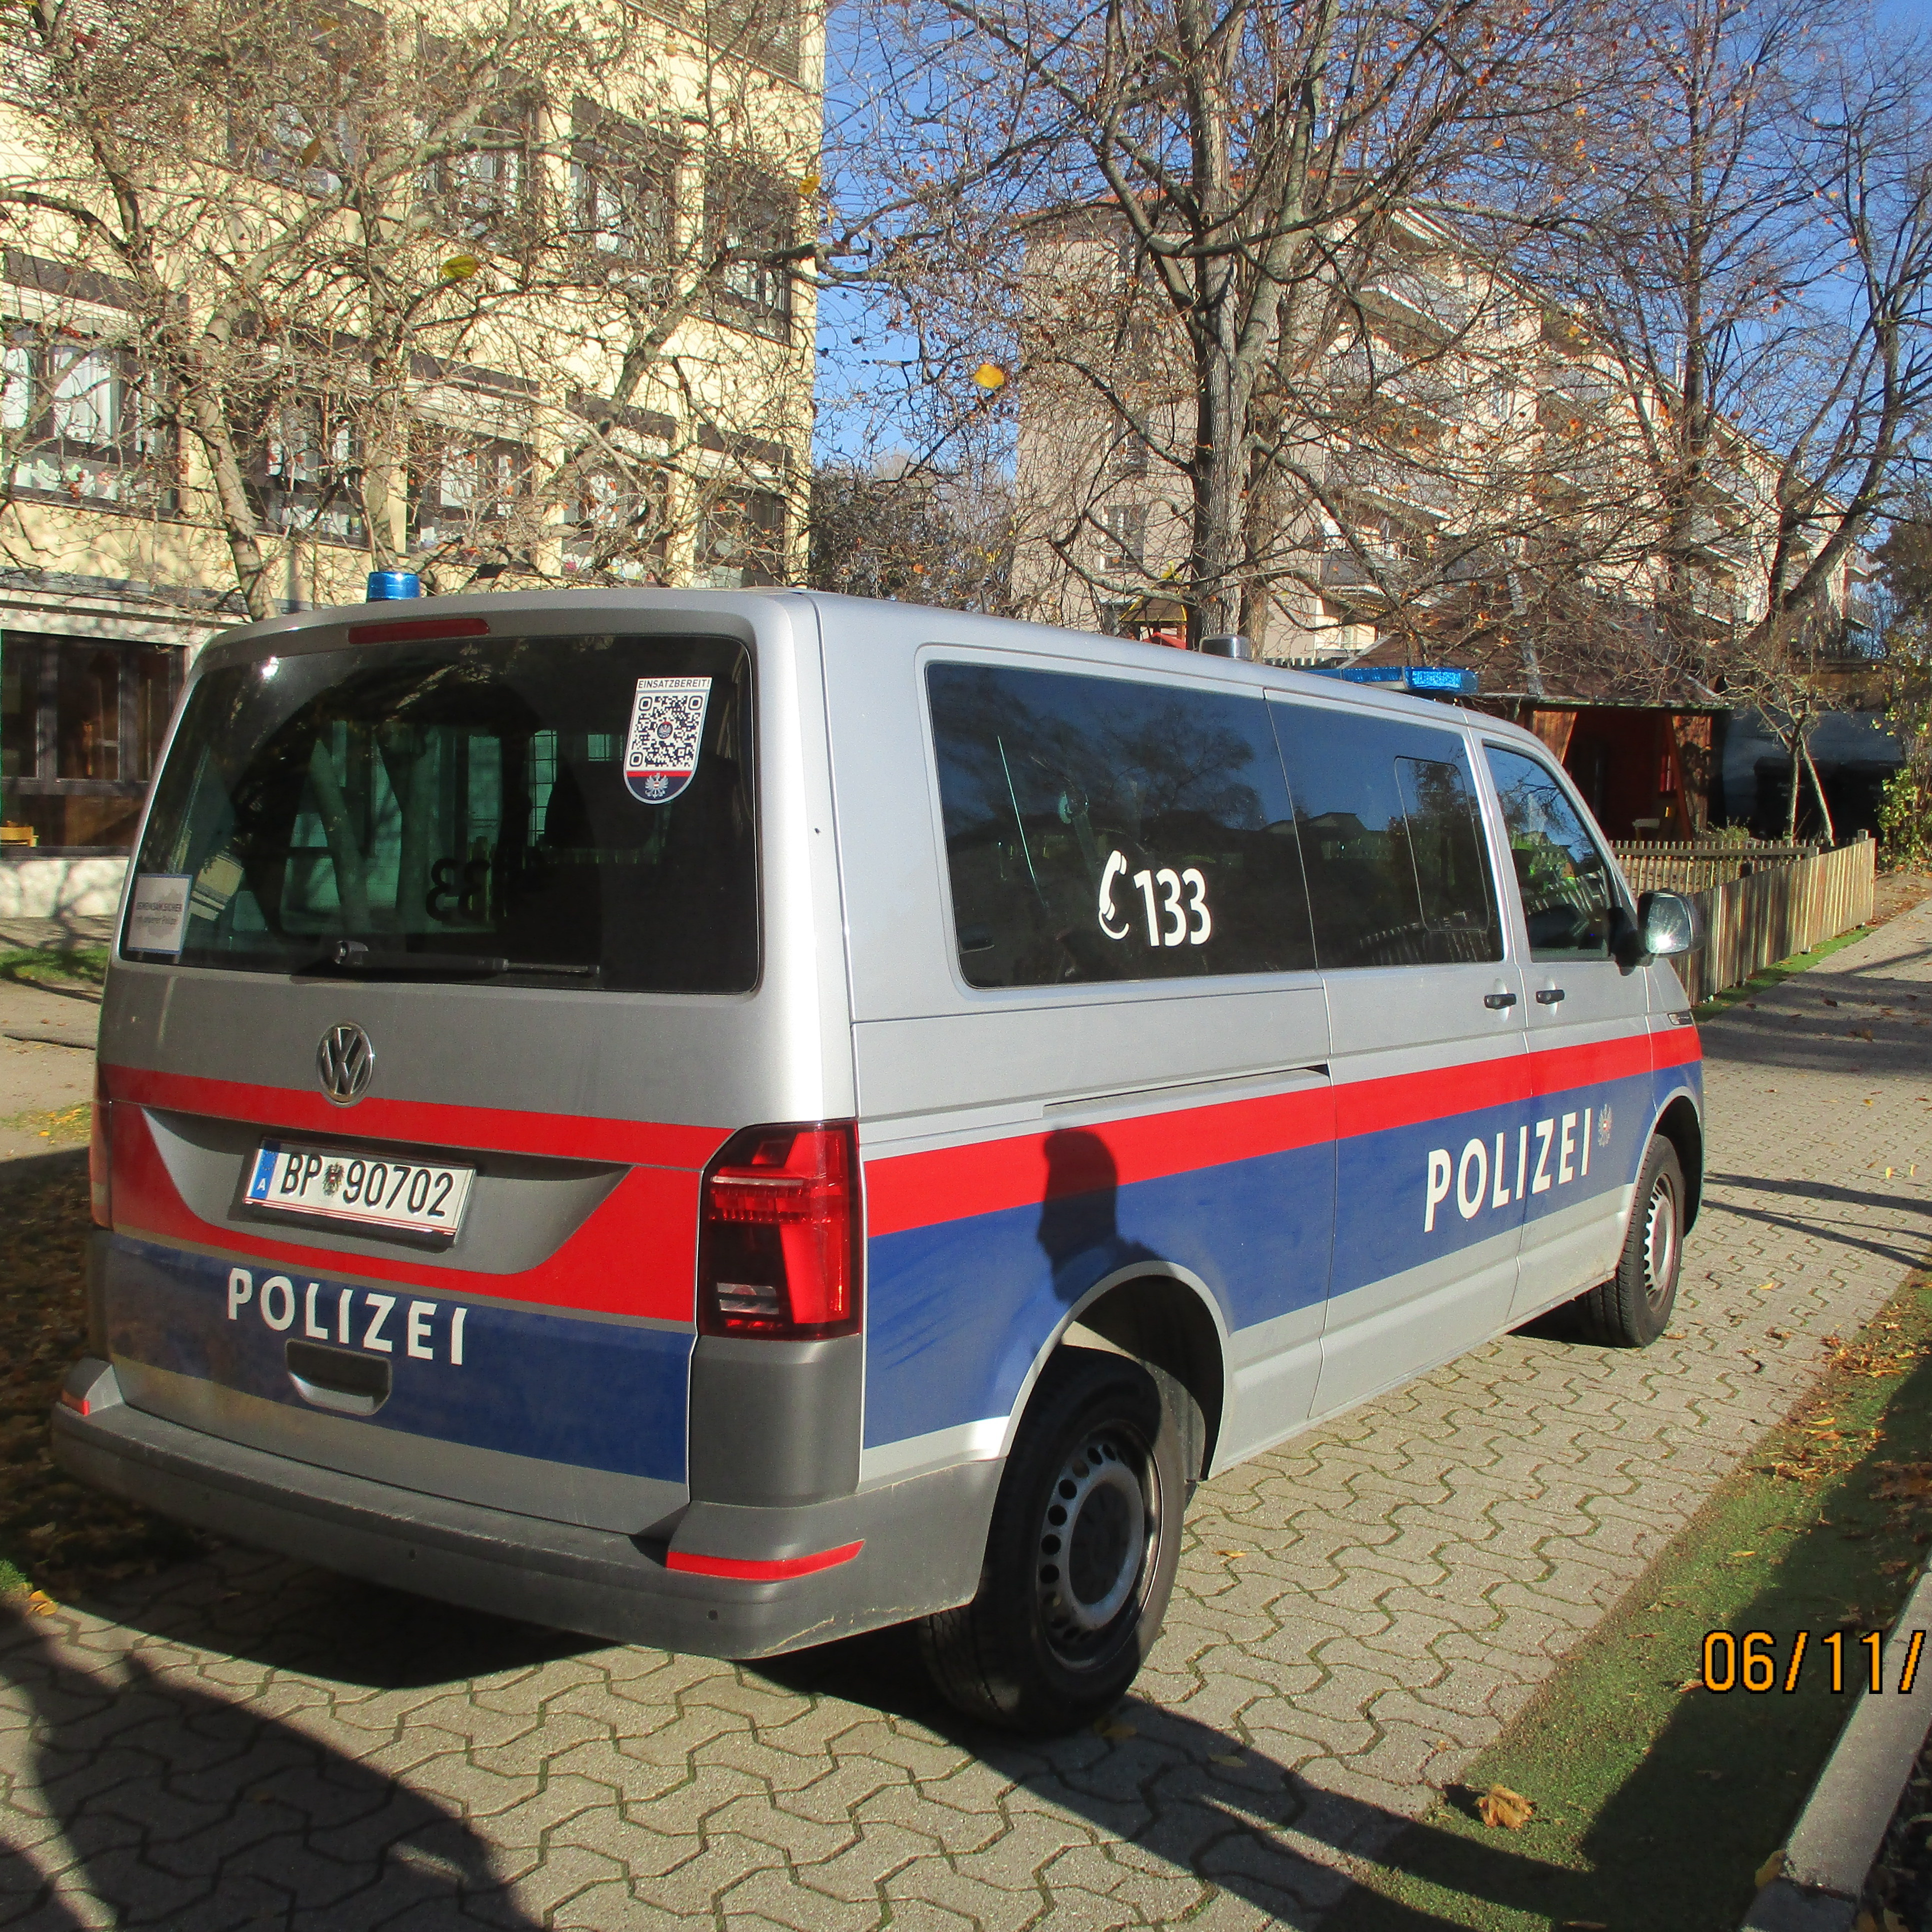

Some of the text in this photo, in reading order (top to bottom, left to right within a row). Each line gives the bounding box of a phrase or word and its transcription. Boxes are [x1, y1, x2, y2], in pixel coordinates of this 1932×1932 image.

[638, 679, 710, 688] EINSATZBEREIT!
[1134, 868, 1212, 946] 133
[319, 1024, 372, 1102] VW
[256, 1154, 454, 1217] A BP 90702
[1424, 1108, 1592, 1232] POLIZEI
[228, 1267, 468, 1366] POLIZEI
